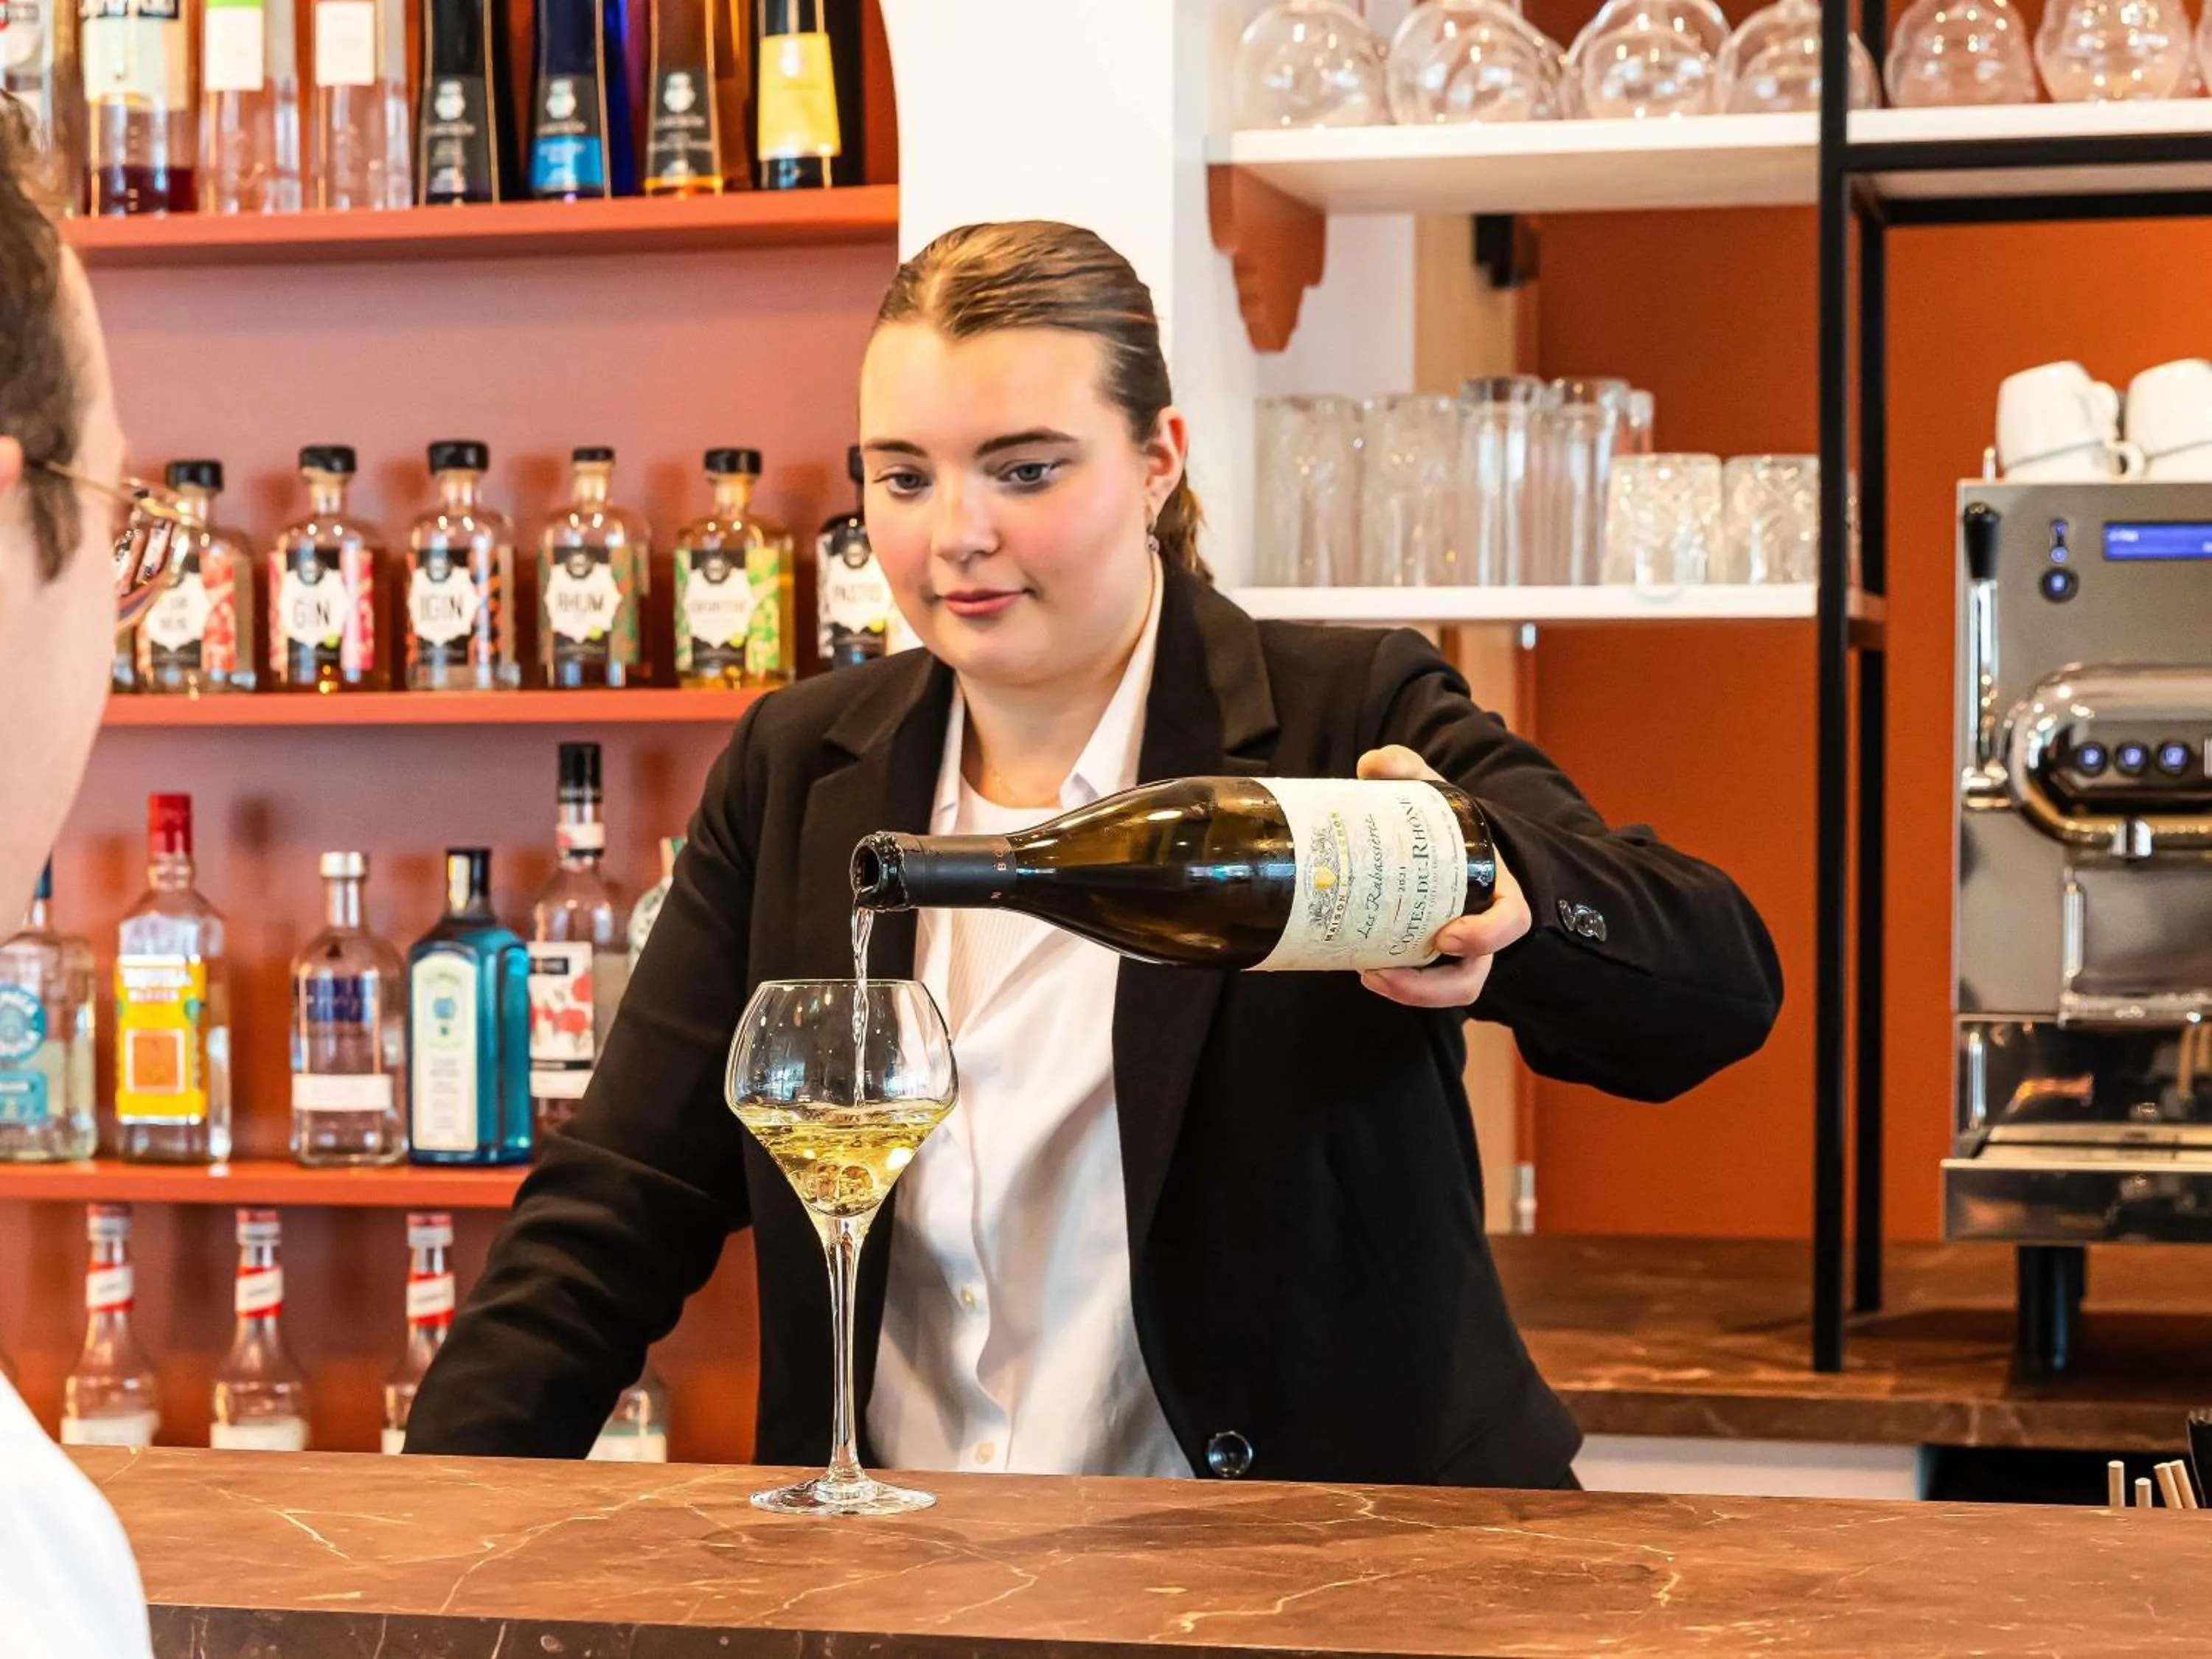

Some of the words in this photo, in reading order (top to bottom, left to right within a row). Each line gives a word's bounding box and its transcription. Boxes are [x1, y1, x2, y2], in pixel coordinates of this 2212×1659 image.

[293, 598, 331, 630] GIN
[556, 591, 605, 613] RHUM
[1397, 866, 1406, 893] 2021
[1324, 894, 1346, 942] MAISON
[1357, 914, 1376, 939] Les
